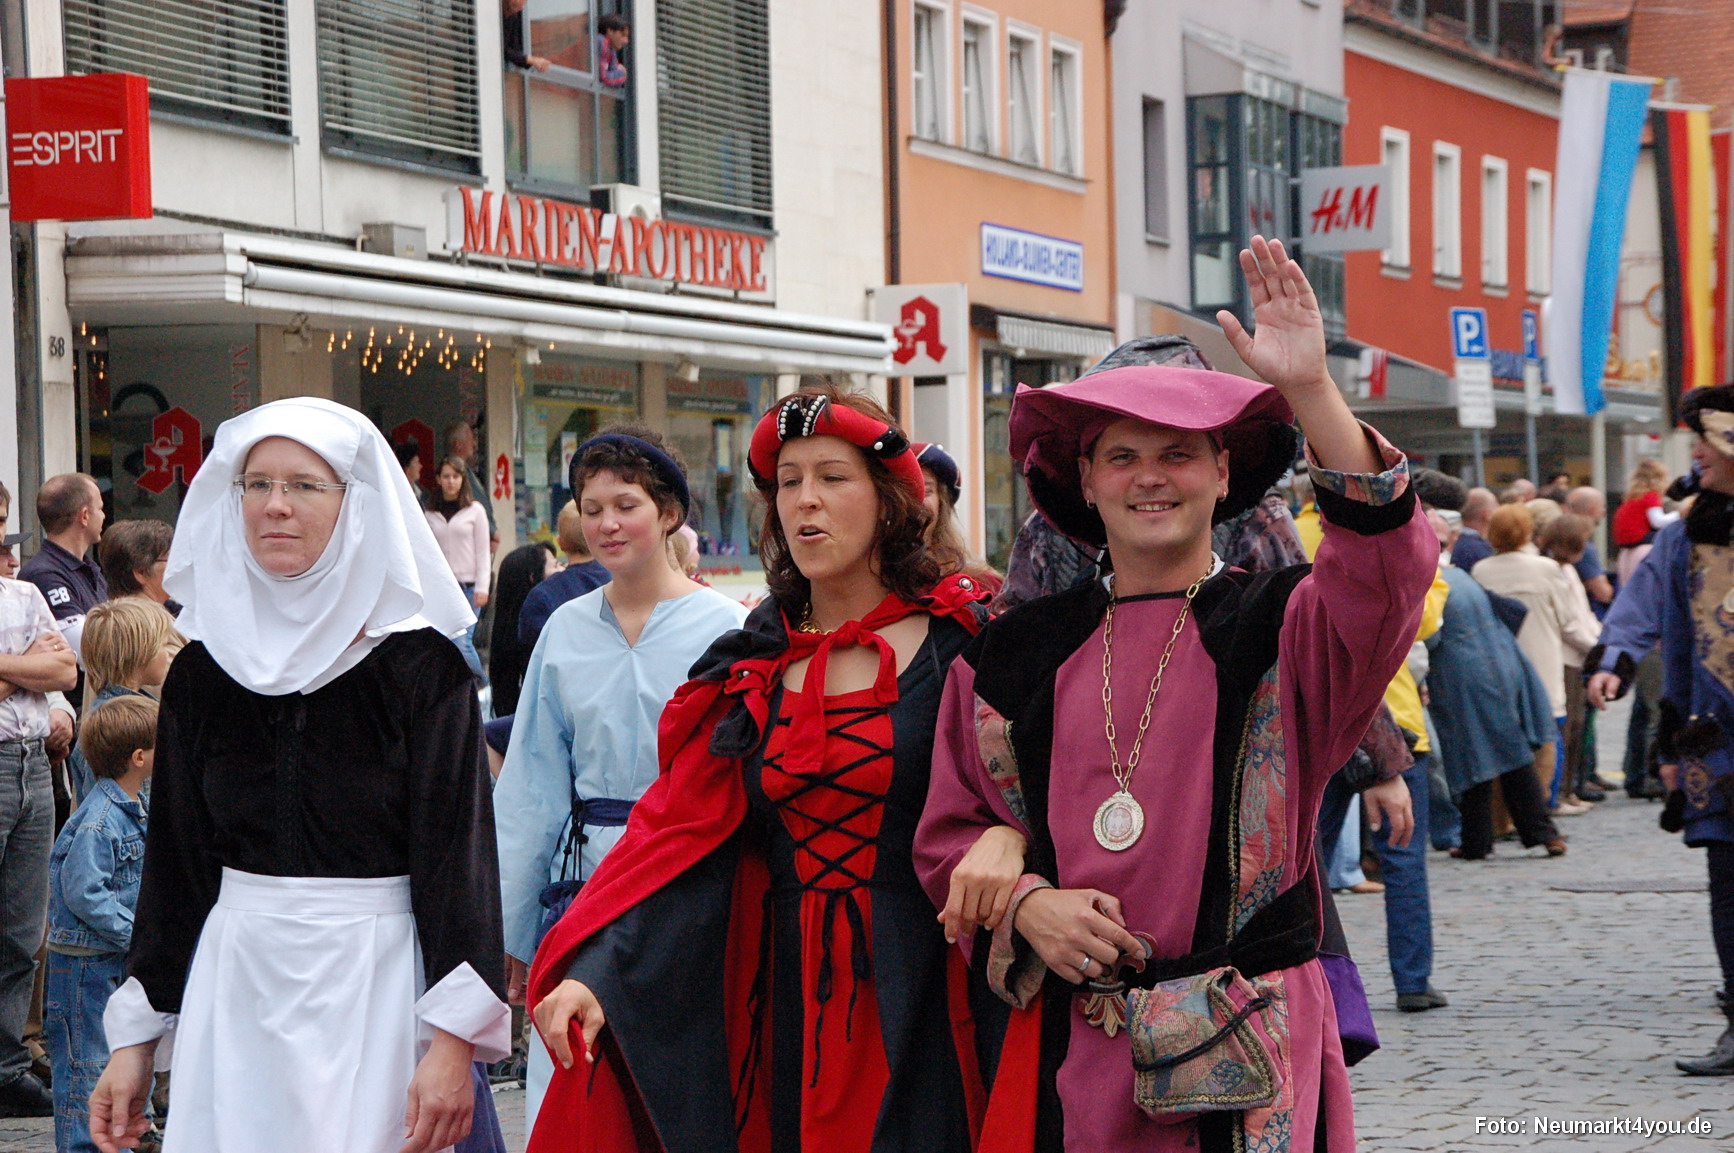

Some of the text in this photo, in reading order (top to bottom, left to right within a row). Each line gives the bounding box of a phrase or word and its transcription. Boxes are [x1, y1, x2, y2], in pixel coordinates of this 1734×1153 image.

[12, 128, 123, 166] ESPRIT
[1311, 183, 1380, 234] H&M
[459, 185, 767, 291] MARIEN-APOTHEKE
[49, 335, 66, 358] 38
[47, 586, 71, 606] 28
